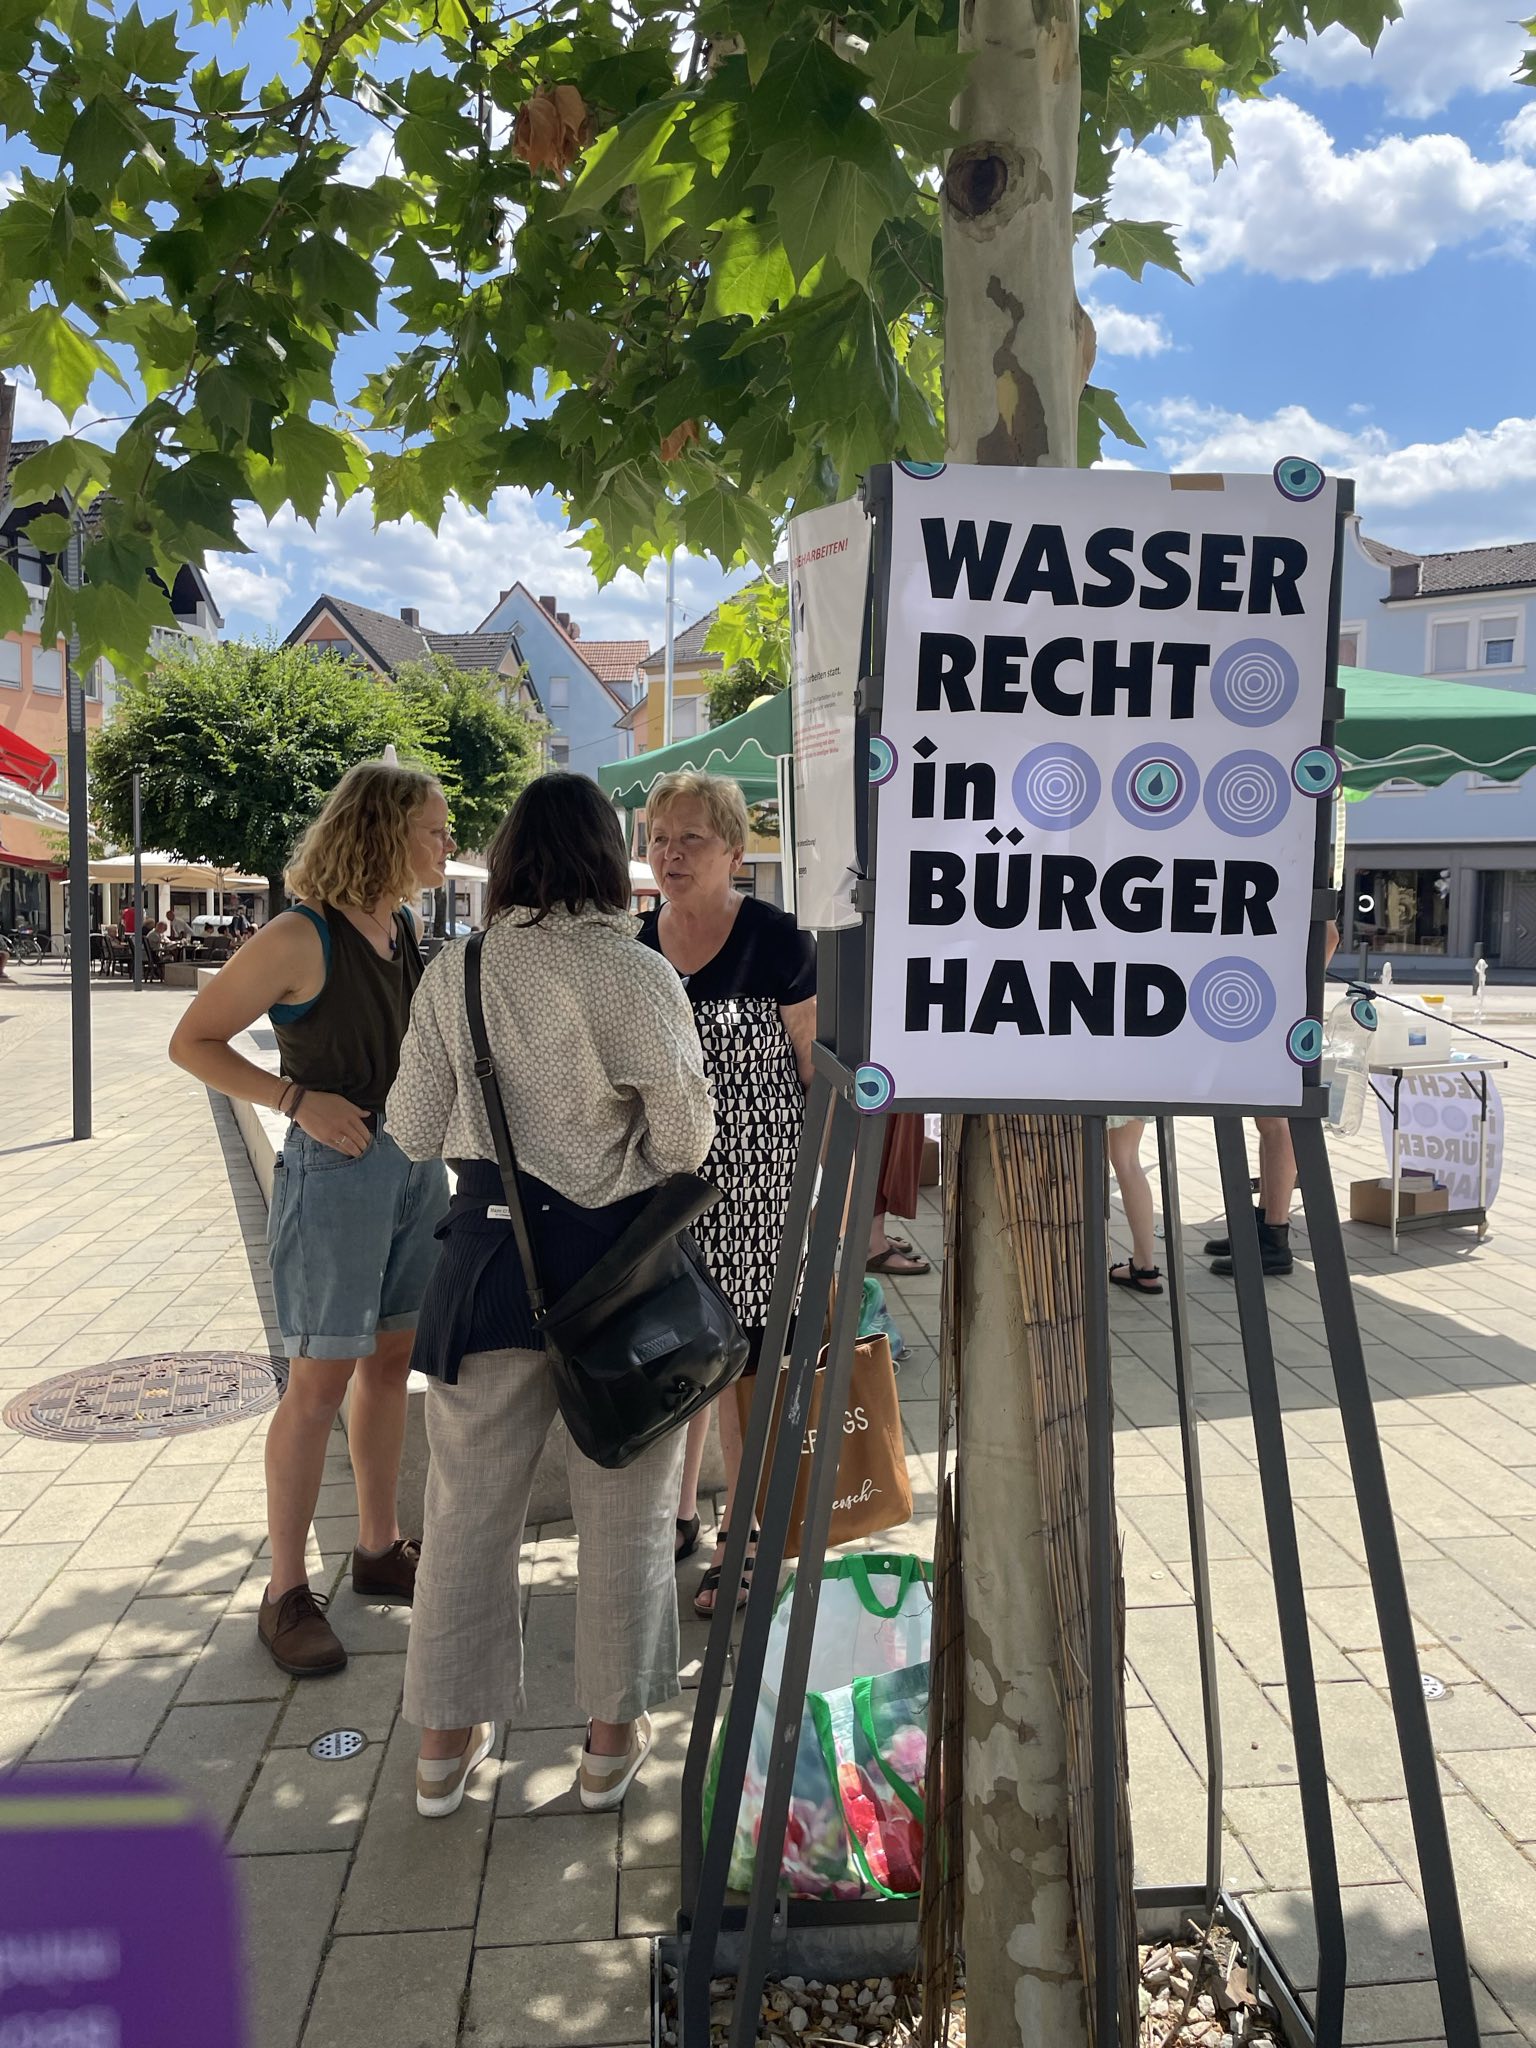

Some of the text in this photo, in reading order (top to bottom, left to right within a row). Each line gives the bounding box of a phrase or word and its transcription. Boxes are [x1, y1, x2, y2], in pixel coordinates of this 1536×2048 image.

[920, 517, 1308, 616] WASSER
[916, 631, 1211, 720] RECHT
[911, 735, 996, 821] in
[908, 826, 1280, 937] BÜRGER
[904, 956, 1187, 1038] HAND
[832, 1478, 882, 1510] ensch
